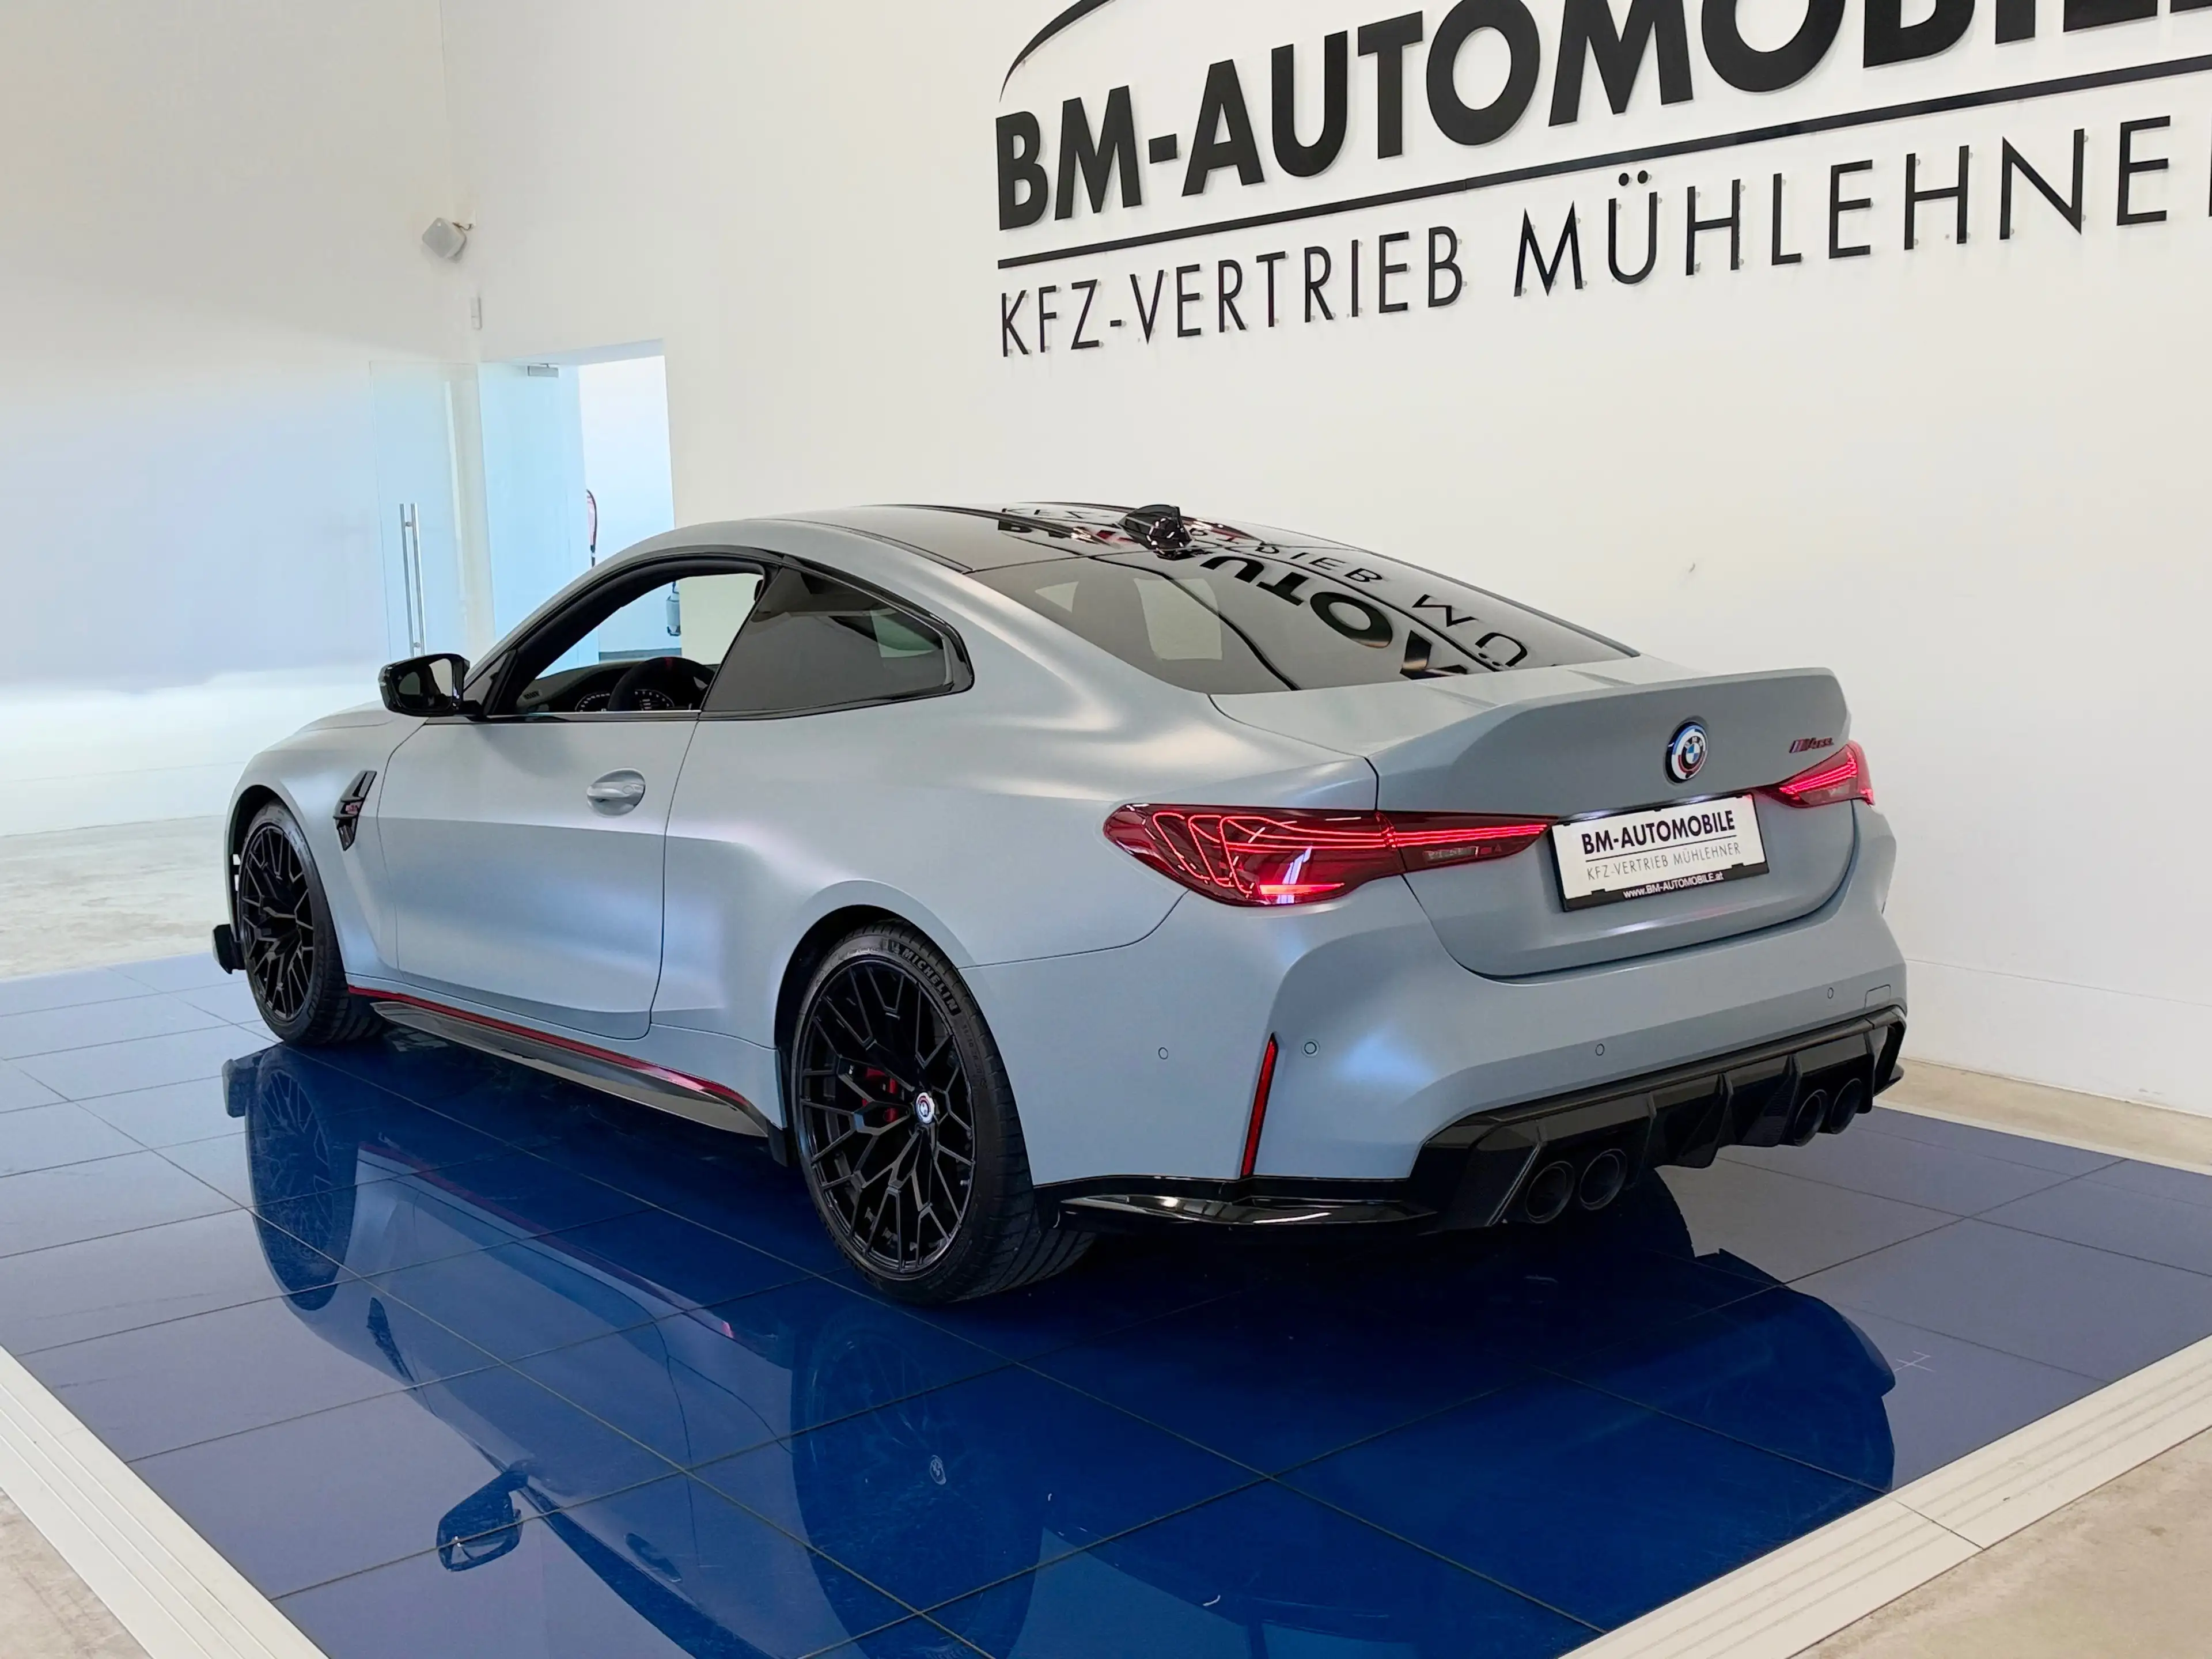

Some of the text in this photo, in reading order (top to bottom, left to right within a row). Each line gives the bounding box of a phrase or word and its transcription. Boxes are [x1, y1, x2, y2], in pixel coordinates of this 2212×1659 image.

[996, 0, 2212, 230] BM-AUTOMO
[1001, 109, 2212, 357] KFZ-VERTRIEB MÜHLEHNE
[1581, 810, 1735, 854] BM-AUTOMOBILE
[1587, 842, 1741, 880] KFZ-VERTRIEB MÜHLEHNER
[1623, 872, 1724, 899] www.BM-AUTOMOBILE.at
[903, 948, 959, 1010] MICHELIN
